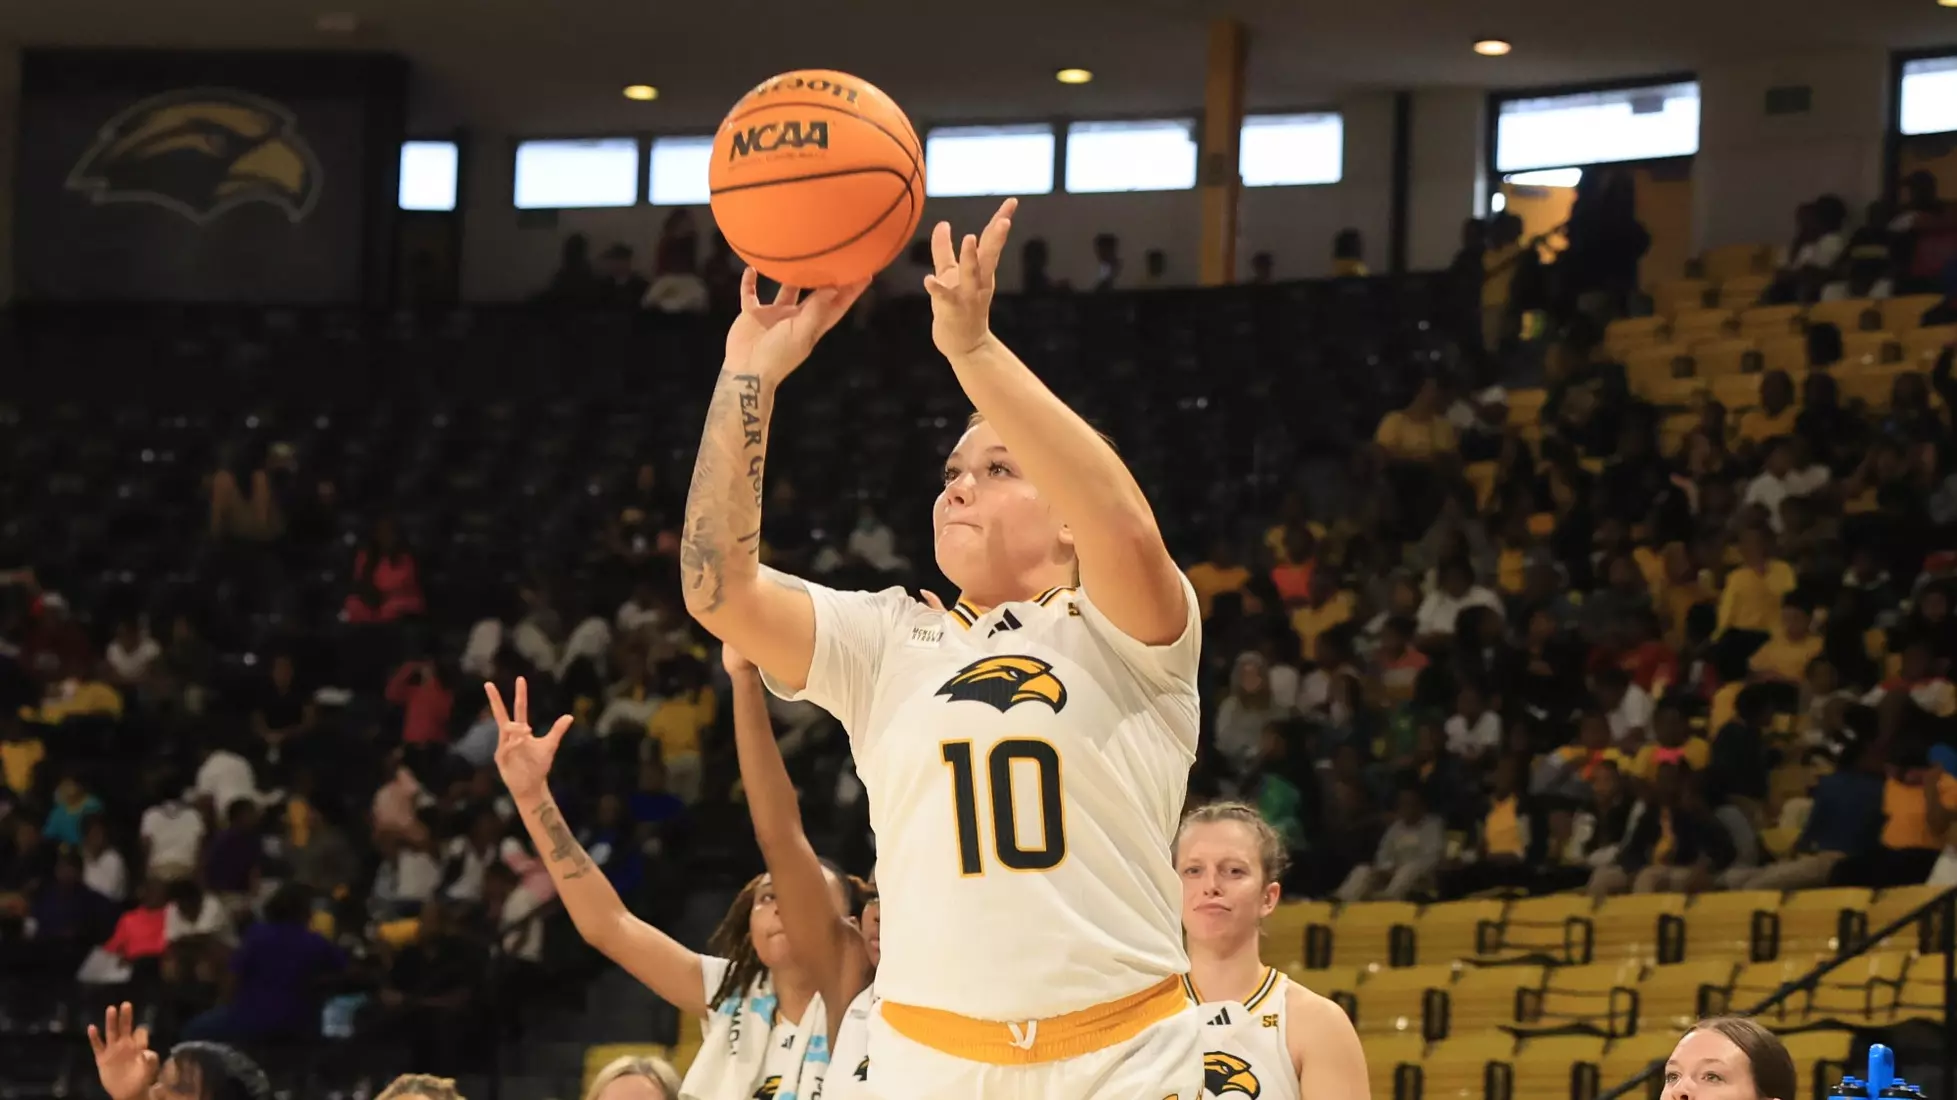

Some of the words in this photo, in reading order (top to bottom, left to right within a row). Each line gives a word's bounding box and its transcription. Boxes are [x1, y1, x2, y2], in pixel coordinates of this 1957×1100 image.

[729, 120, 829, 162] NCAA
[733, 373, 762, 450] FEAR
[939, 736, 1068, 878] 10
